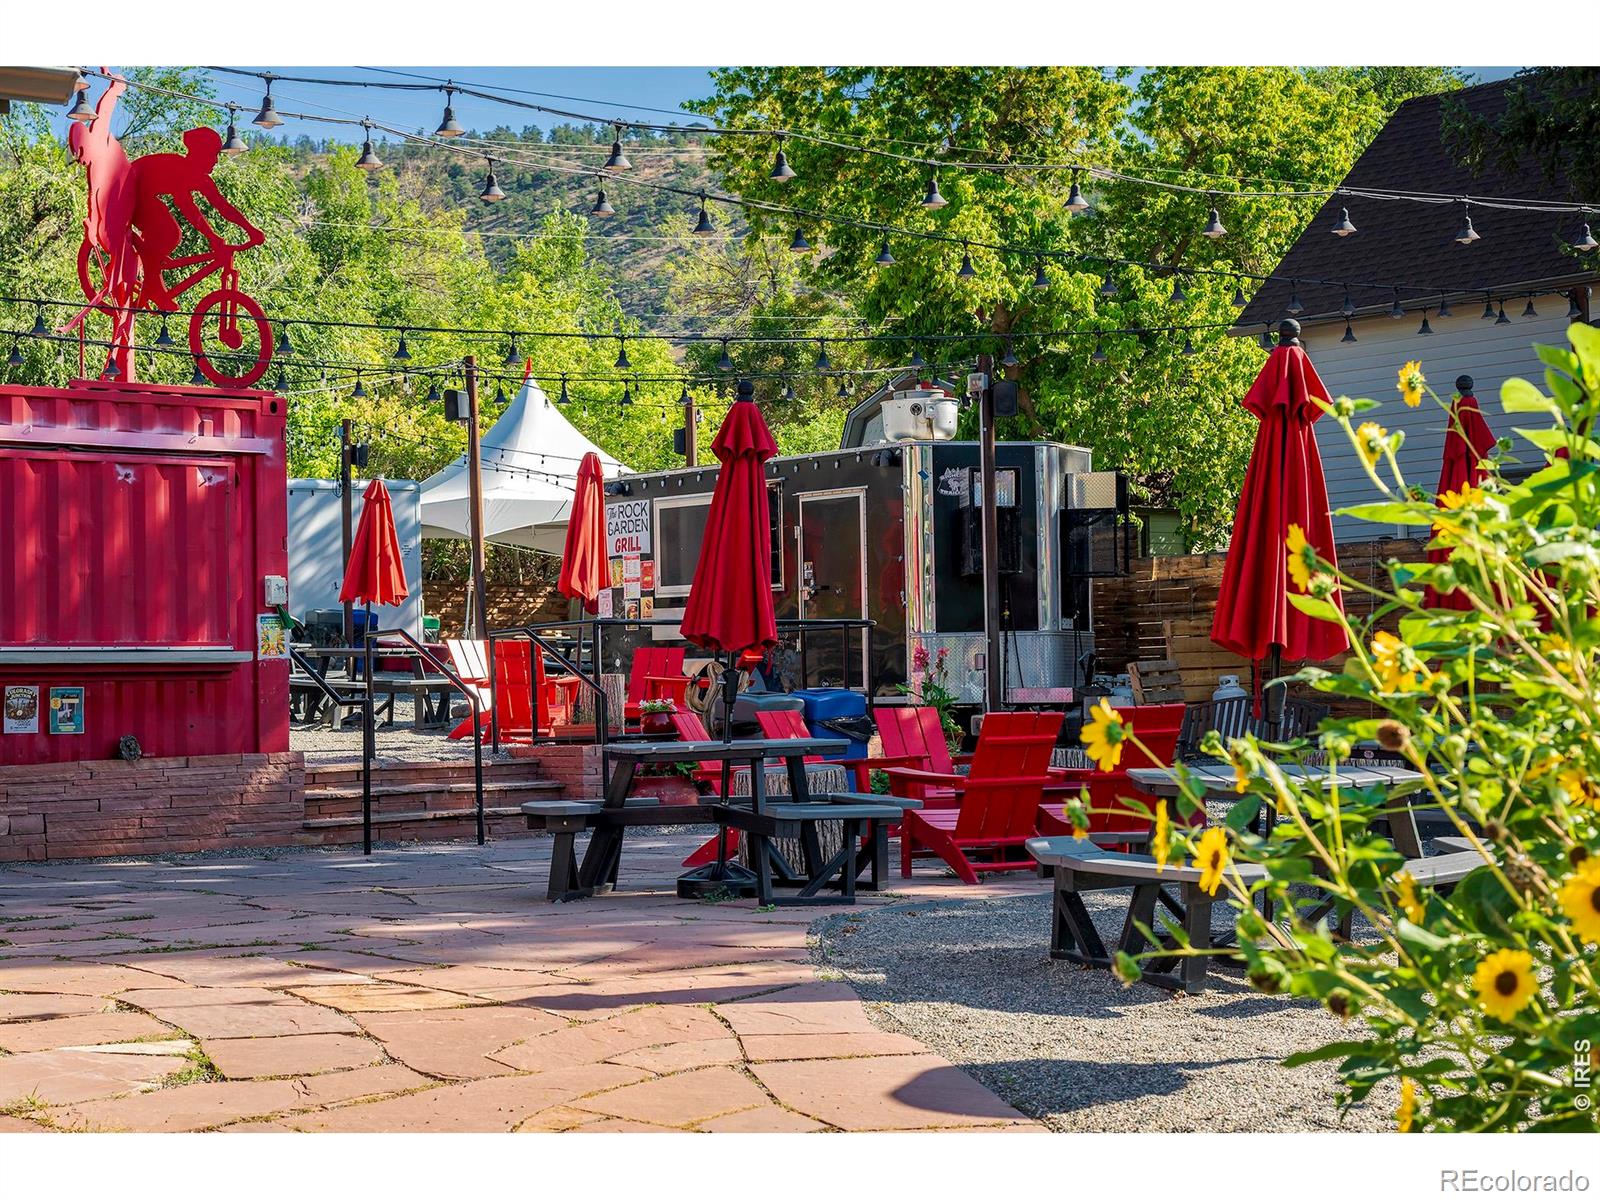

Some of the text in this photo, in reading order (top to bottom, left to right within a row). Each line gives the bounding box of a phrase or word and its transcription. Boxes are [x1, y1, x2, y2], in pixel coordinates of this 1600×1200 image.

[607, 502, 648, 519] The ROCK
[607, 519, 648, 537] GARDEN
[615, 536, 642, 553] GRILL
